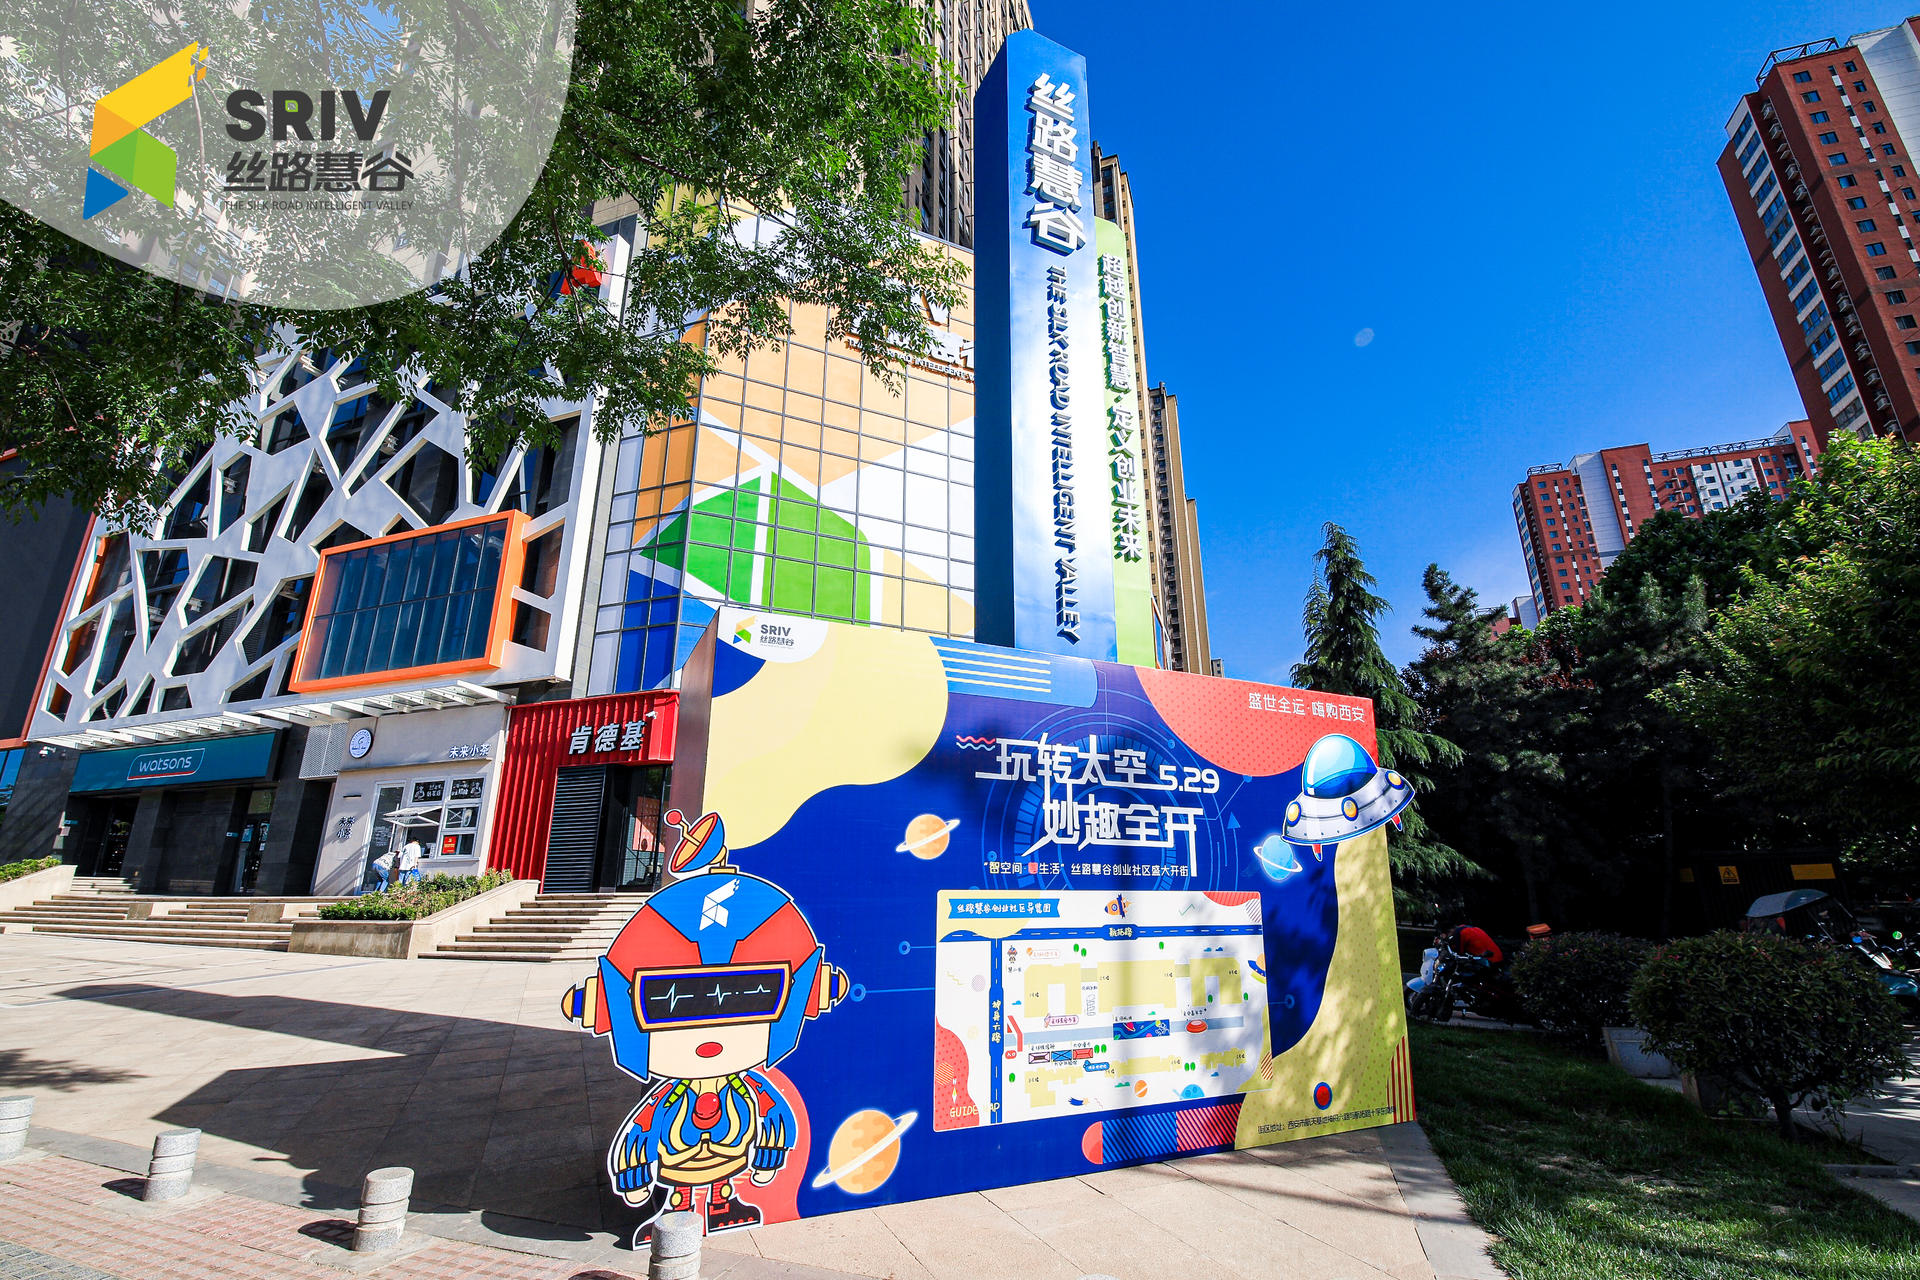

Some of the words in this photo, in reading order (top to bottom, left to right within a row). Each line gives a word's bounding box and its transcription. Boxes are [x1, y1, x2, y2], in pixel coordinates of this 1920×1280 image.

[1024, 72, 1086, 257] 丝路慧谷
[1047, 265, 1068, 304] THE
[1048, 304, 1070, 350] SILK
[1049, 349, 1071, 410] ROAD
[1050, 412, 1077, 554] INTELLIGENT
[1055, 557, 1081, 646] VALLEY
[760, 624, 791, 637] SRIV
[760, 635, 794, 647] 丝路慧谷
[1248, 692, 1365, 722] 盛世全运·嗨购西安
[448, 743, 491, 759] 未来小茶
[569, 720, 647, 755] 肯德基
[139, 755, 192, 773] watsons
[975, 733, 1158, 788] 玩转太空
[1159, 765, 1220, 794] 5.29
[1022, 794, 1204, 877] 妙趣全开
[950, 1104, 979, 1118] GUIDE
